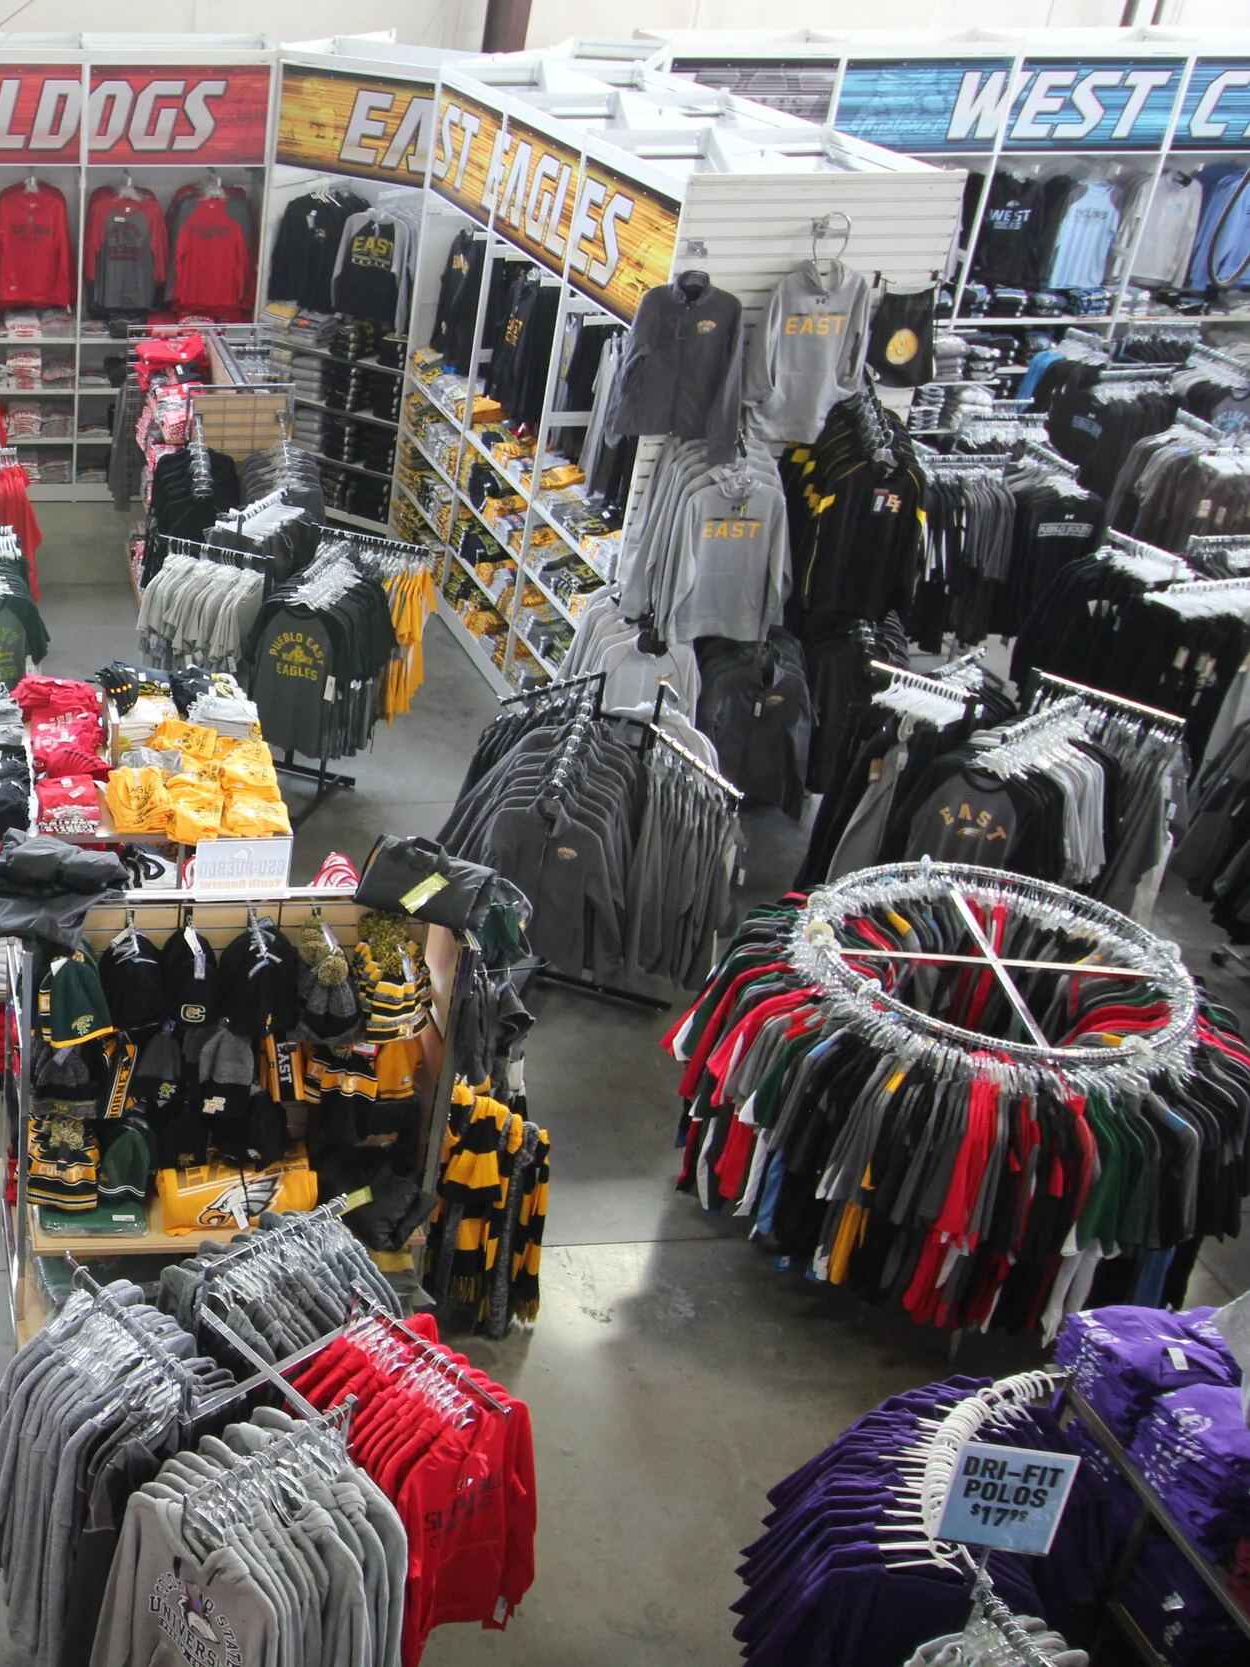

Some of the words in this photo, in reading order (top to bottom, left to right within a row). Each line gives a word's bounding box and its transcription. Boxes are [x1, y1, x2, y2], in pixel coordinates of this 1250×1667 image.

[946, 70, 1174, 140] WEST
[338, 89, 480, 191] EAST
[480, 128, 635, 289] EAGLES
[990, 208, 1032, 222] WEST
[352, 236, 394, 257] EAST
[784, 315, 846, 335] EAST
[703, 521, 762, 538] EAST
[269, 632, 303, 656] PUEBLO
[305, 637, 325, 666] EAST
[276, 662, 318, 681] EAGLES
[939, 803, 1009, 842] EAST
[277, 1042, 293, 1084] EAST
[963, 1455, 1065, 1488] DRI-FIT
[963, 1478, 1048, 1508] POLOS
